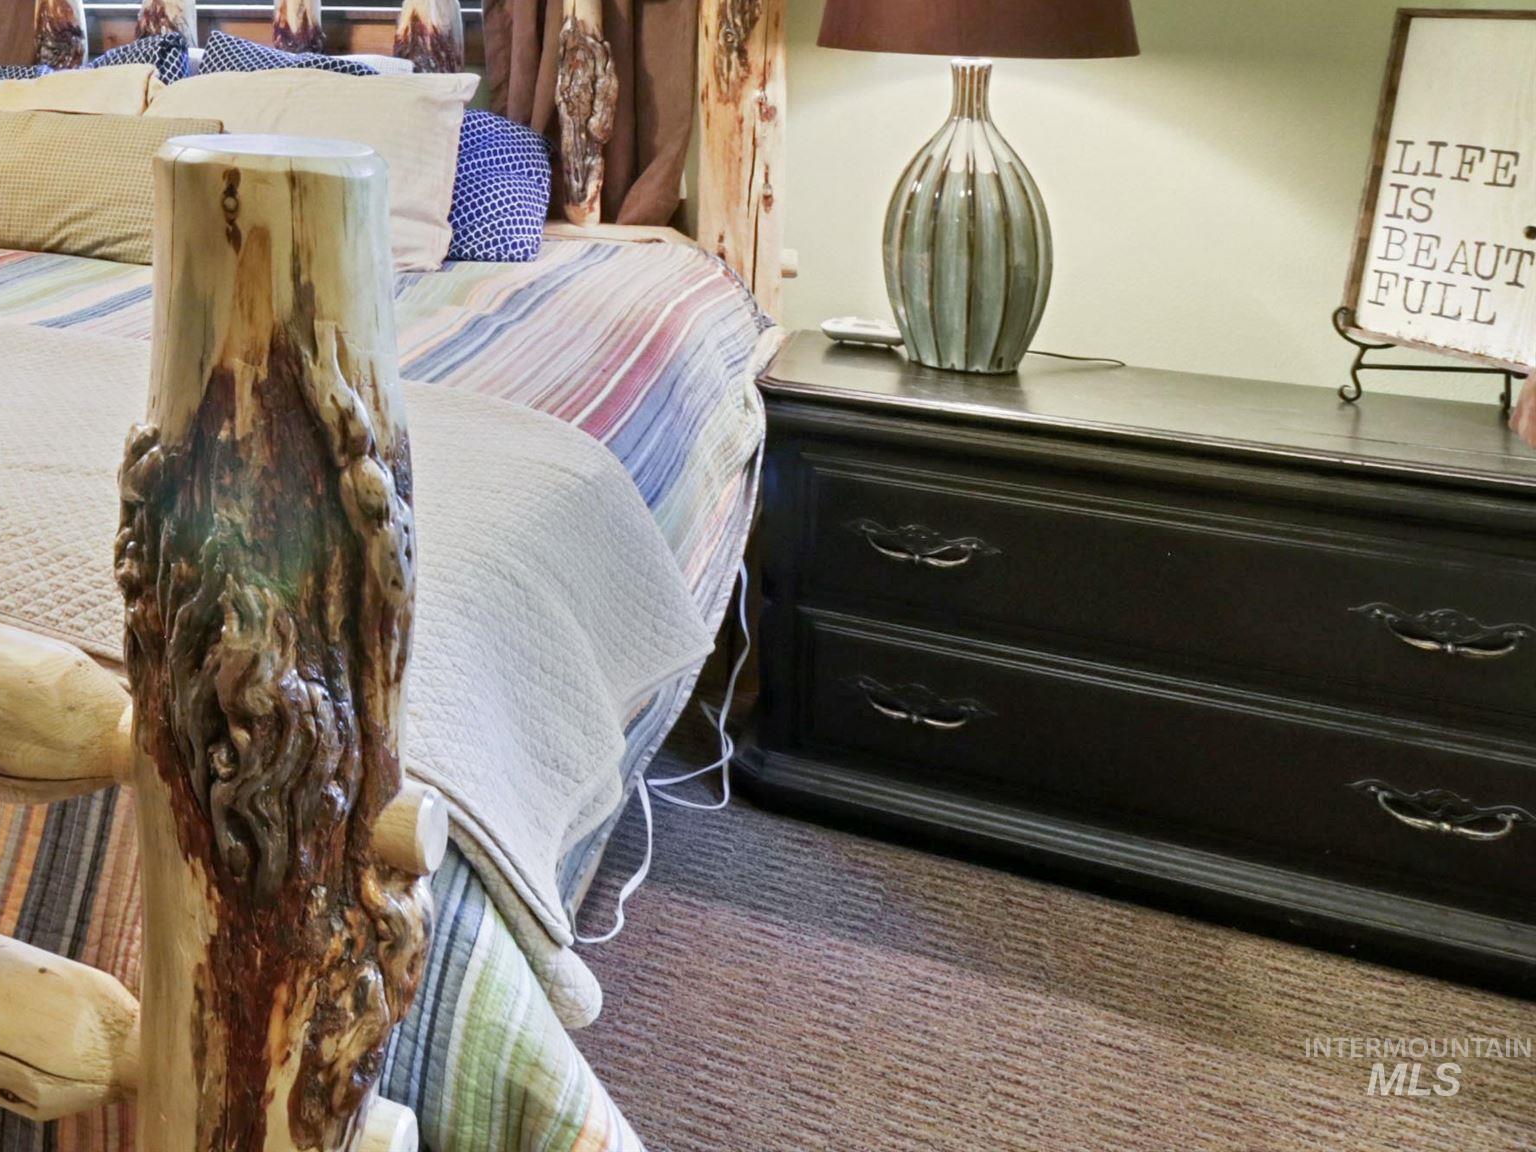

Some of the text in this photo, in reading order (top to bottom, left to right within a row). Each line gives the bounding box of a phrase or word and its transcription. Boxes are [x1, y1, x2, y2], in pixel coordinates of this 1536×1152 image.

[1391, 139, 1520, 188] LIFE
[1384, 183, 1435, 223] IS
[1377, 225, 1534, 288] BEAUT
[1367, 269, 1497, 326] FULL
